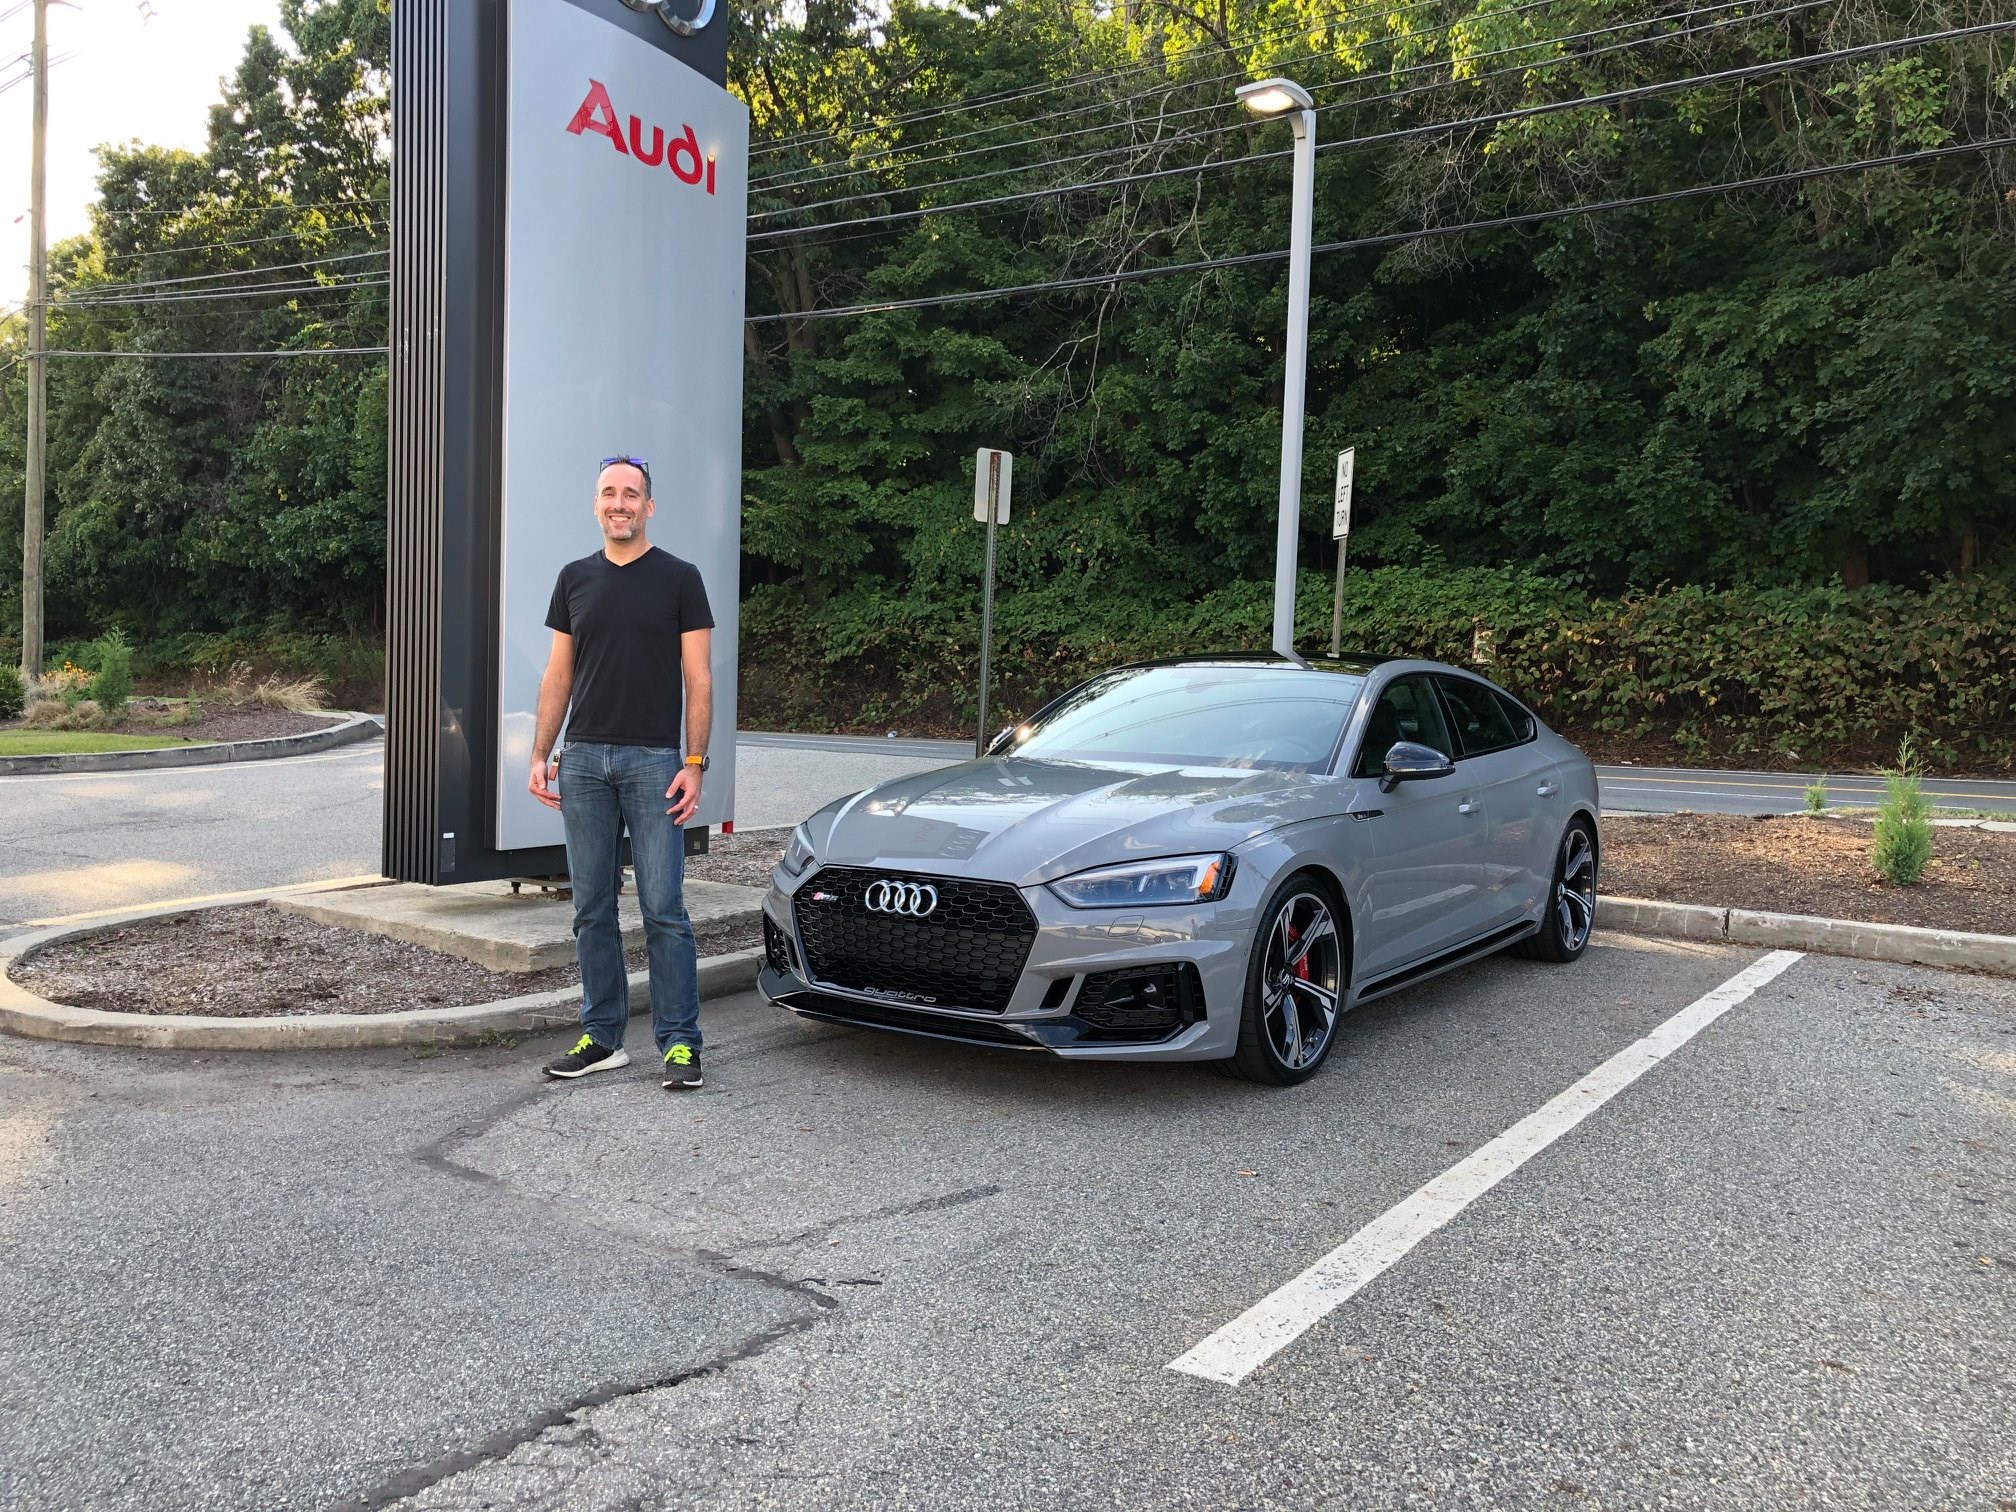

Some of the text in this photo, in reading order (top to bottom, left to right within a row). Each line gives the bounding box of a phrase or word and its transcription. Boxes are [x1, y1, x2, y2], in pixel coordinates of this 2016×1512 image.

[566, 78, 716, 196] Audi
[1337, 484, 1350, 503] LEFT
[863, 986, 937, 1003] quattro
